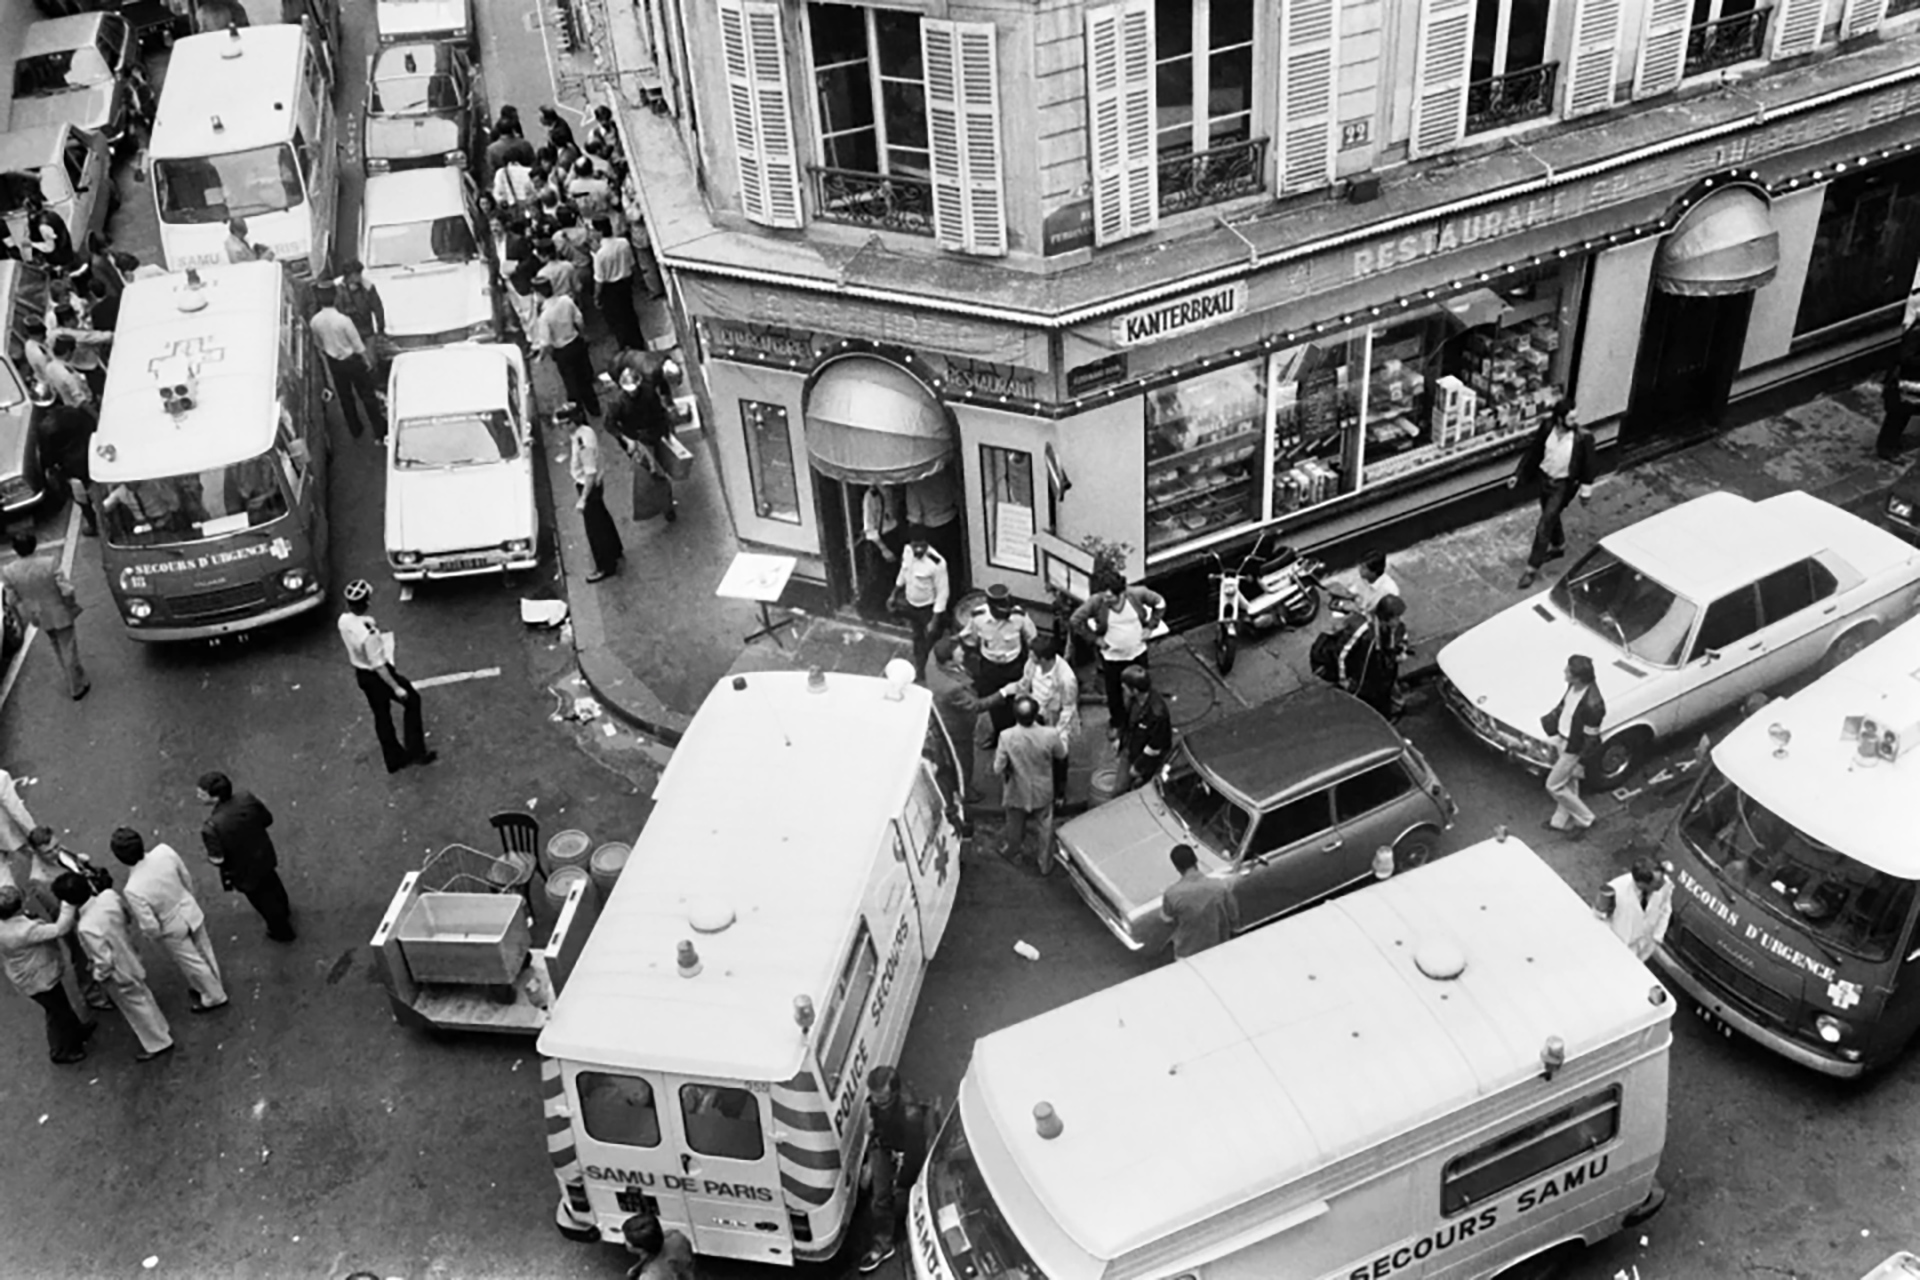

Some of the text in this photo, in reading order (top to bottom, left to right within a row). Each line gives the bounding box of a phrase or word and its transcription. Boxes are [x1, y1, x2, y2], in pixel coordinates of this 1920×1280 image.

[1346, 123, 1365, 143] 22
[177, 253, 219, 268] SAMU
[135, 543, 269, 575] SECOURS D'URGENCE
[1677, 869, 1740, 927] SECOURS
[1744, 922, 1836, 982] D'URGENCE
[834, 913, 909, 1138] POLICE SECOURS
[587, 1164, 773, 1203] SAMU DE PARIS
[1349, 1154, 1609, 1280] SECOURS SAMU
